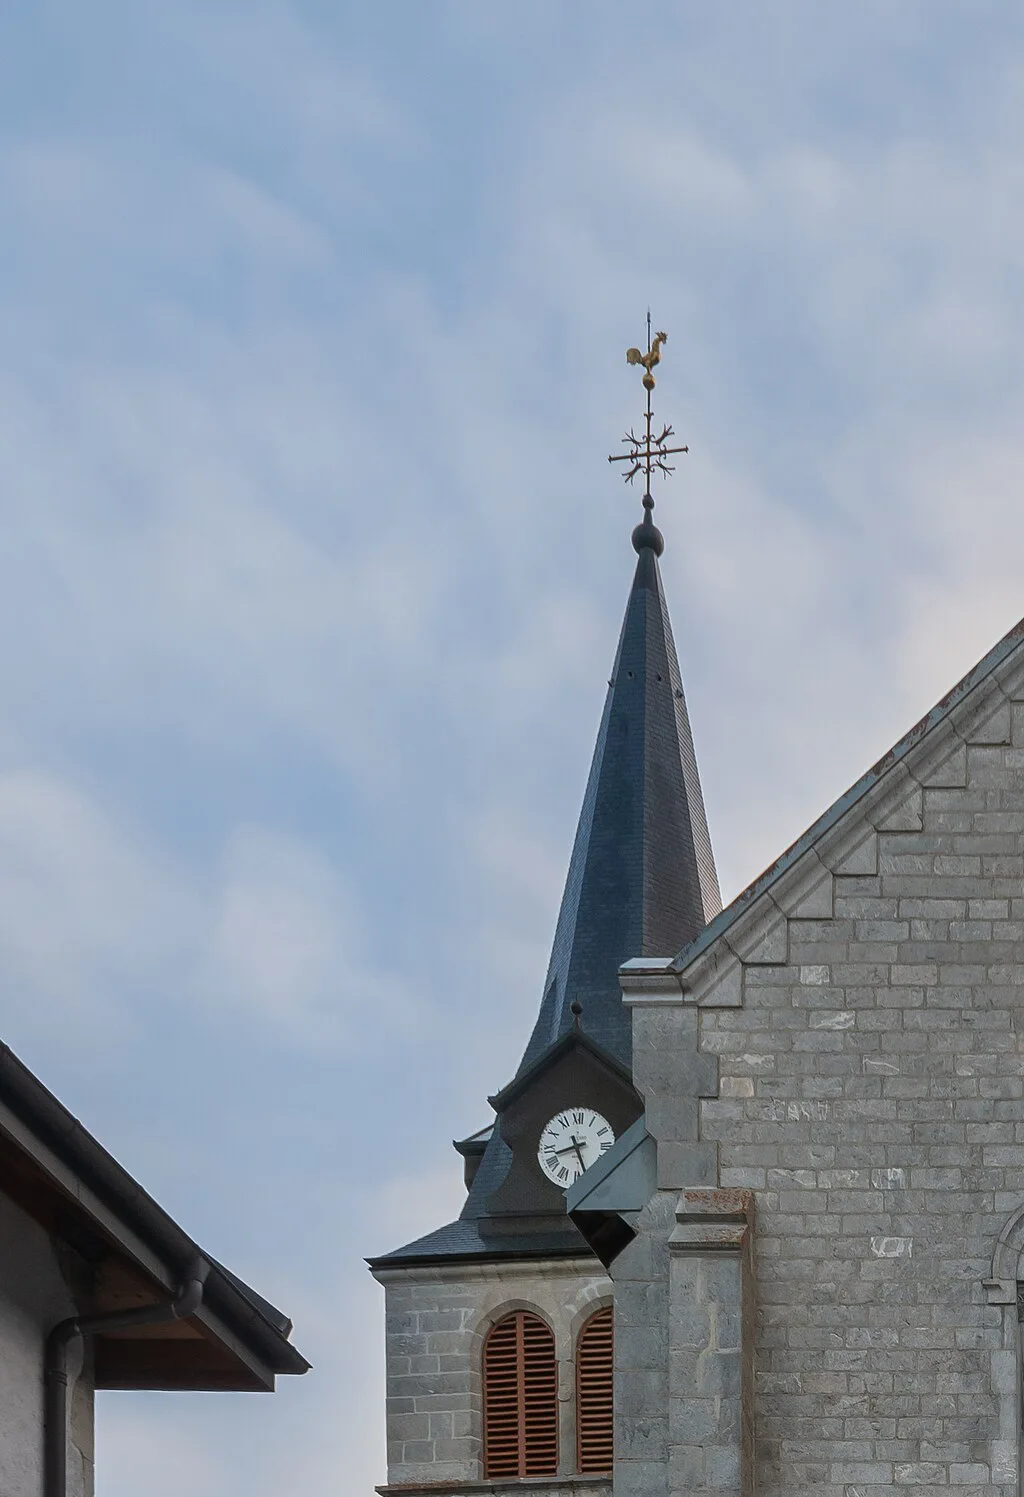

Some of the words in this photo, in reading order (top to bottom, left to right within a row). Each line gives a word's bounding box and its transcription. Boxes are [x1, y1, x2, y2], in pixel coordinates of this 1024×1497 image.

[558, 1116, 570, 1130] XI
[573, 1112, 584, 1125] XII
[588, 1116, 596, 1127] I
[547, 1129, 560, 1139] X
[596, 1127, 609, 1137] II
[543, 1144, 556, 1154] IX
[546, 1155, 560, 1172] VIII
[557, 1166, 570, 1181] VII
